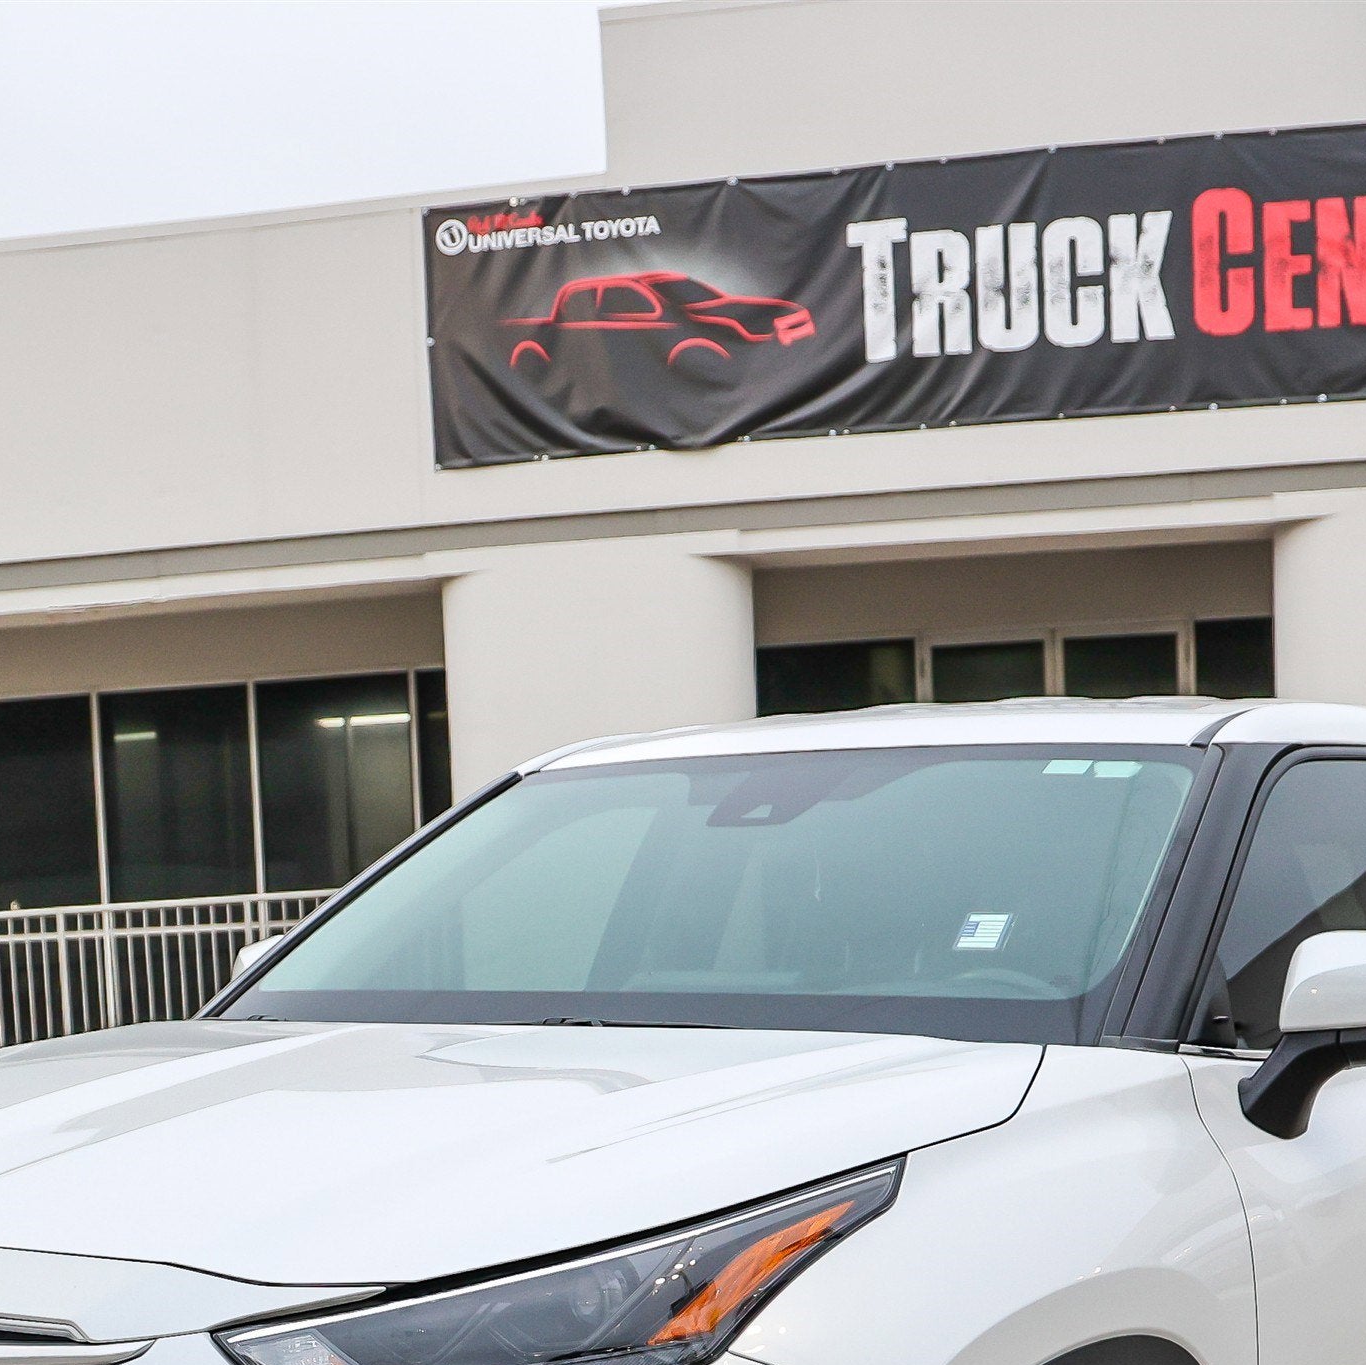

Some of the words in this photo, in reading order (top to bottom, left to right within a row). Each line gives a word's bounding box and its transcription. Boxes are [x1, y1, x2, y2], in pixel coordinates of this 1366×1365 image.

[467, 223, 581, 254] UNIVERSAL
[581, 215, 663, 242] TOYOTA
[845, 210, 1176, 364] TRUCK
